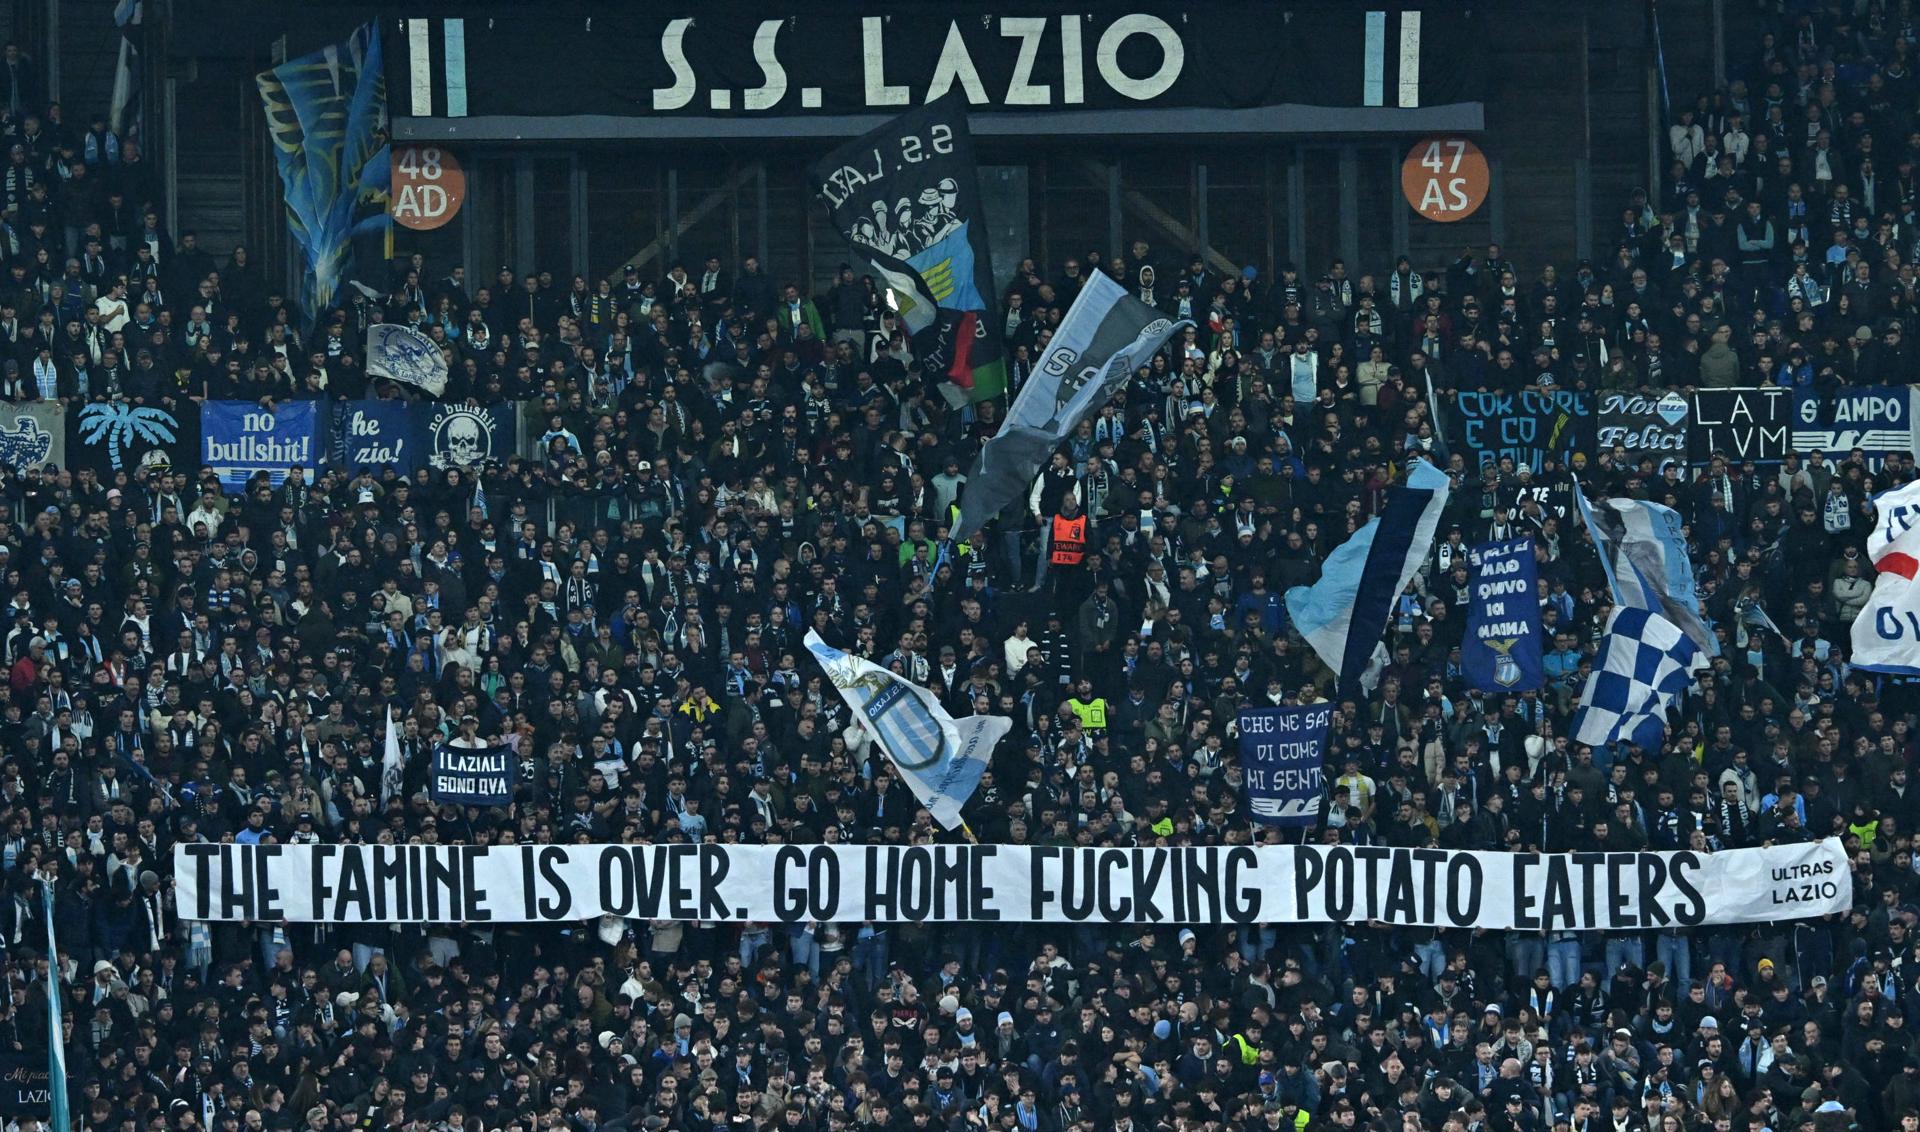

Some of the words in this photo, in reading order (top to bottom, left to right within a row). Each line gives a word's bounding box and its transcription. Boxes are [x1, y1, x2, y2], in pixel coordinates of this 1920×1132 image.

[653, 18, 822, 110] S.S.
[863, 14, 1185, 106] LAZIO
[399, 149, 442, 180] 48
[1422, 141, 1465, 173] 47
[395, 185, 447, 217] AD
[1420, 178, 1468, 211] AS
[429, 412, 443, 433] no
[444, 402, 498, 433] bullshit
[1598, 395, 1662, 415] Noi
[1695, 391, 1783, 425] LAT
[1800, 396, 1902, 424] SAMPO
[243, 413, 275, 432] no
[1466, 420, 1484, 448] E
[207, 435, 310, 463] bullshit!
[1597, 424, 1687, 450] Felici
[1241, 716, 1274, 733] CHE
[1305, 709, 1330, 730] SAI
[440, 752, 445, 769] I
[447, 753, 506, 772] LAZIALI
[1257, 744, 1274, 761] DI
[1279, 740, 1319, 760] COME
[437, 775, 475, 794] SONO
[478, 777, 507, 796] QVA
[1247, 768, 1266, 790] MI
[1273, 766, 1322, 791] SENT
[1771, 860, 1834, 881] ULTRAS
[185, 844, 285, 920] THE
[312, 844, 491, 921] FAMINE
[522, 846, 572, 919] IS
[599, 844, 748, 920] OVER.
[773, 845, 840, 921] GO
[865, 844, 1000, 921] HOME
[1031, 846, 1262, 923] FUCKING
[1294, 845, 1483, 927] POTATO
[1513, 850, 1707, 929] EATERS
[1772, 881, 1837, 905] LAZIO
